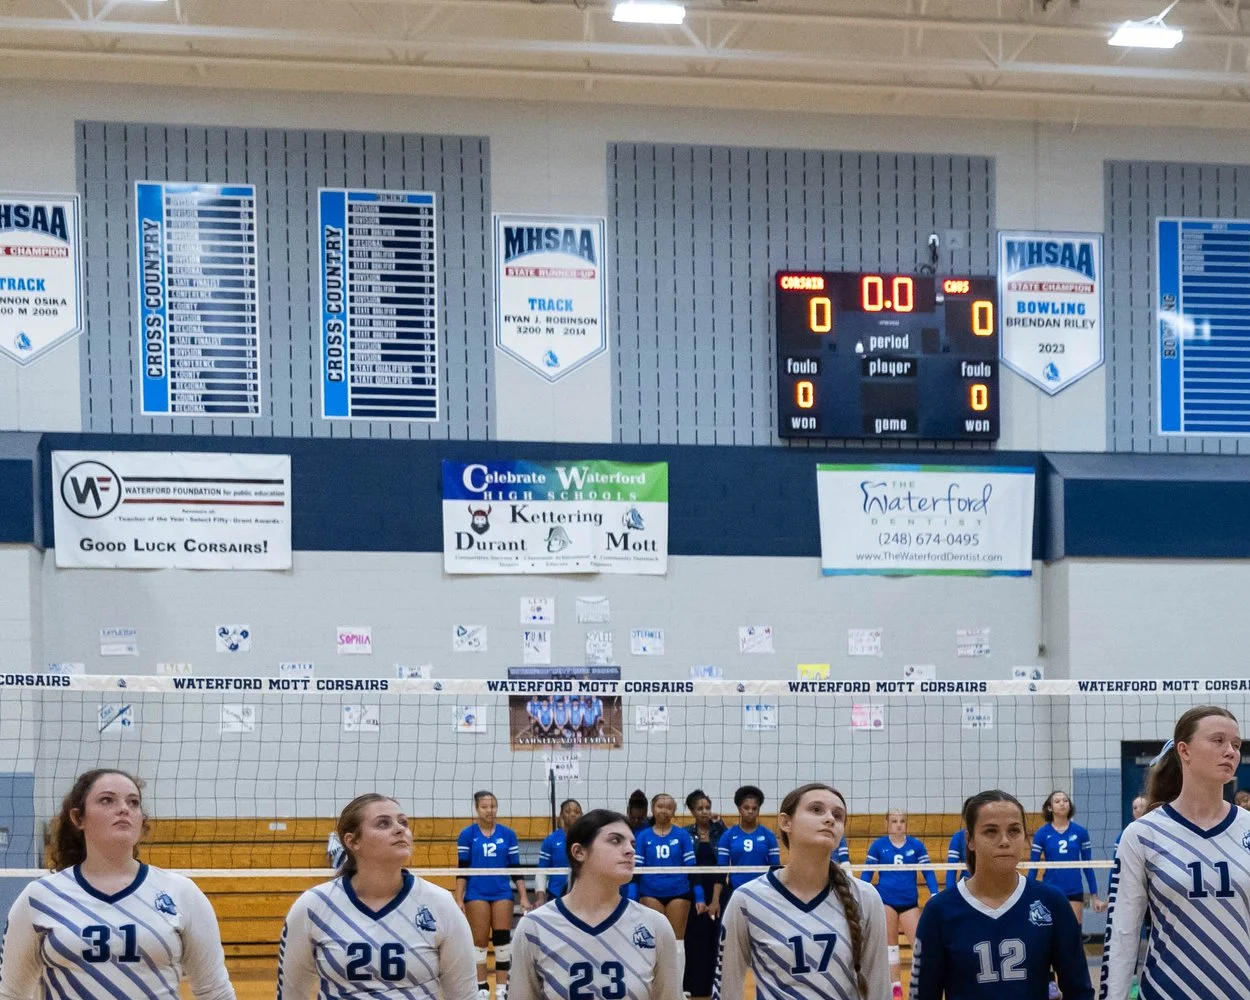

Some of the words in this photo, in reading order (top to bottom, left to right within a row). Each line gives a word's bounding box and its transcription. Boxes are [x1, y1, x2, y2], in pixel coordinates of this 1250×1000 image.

[0, 203, 70, 244] HSAA
[12, 247, 67, 258] CHAMPION
[504, 227, 597, 264] MHSAA
[143, 220, 162, 309] COUNTRY
[1006, 241, 1095, 280] MHSAA
[325, 227, 342, 314] COUNTRY
[508, 268, 536, 277] STATE
[0, 278, 46, 291] TRACK
[1011, 283, 1039, 291] STATE
[1043, 284, 1092, 293] CHAMPION
[0, 297, 30, 305] NNON
[34, 298, 68, 306] OSIKA
[780, 276, 825, 291] CORSAIR
[862, 276, 914, 312] 0.0
[0, 307, 14, 315] 00
[528, 298, 573, 312] TRACK
[1017, 301, 1086, 315] BOWLING
[504, 315, 530, 323] RYAN
[546, 315, 598, 325] ROBINSON
[810, 297, 832, 333] 0
[972, 300, 994, 336] 0
[1006, 318, 1060, 329] BRENDAN
[1064, 318, 1096, 329] RILEY
[516, 327, 541, 335] 3200
[545, 327, 555, 335] M
[563, 328, 586, 336] 2014
[146, 316, 164, 379] CROSS
[870, 334, 910, 352] period
[1038, 343, 1065, 354] 2023
[327, 322, 343, 382] CROSS
[787, 358, 818, 374] fouls
[869, 360, 911, 377] player
[961, 361, 992, 377] fouls
[796, 381, 814, 409] 0
[970, 384, 988, 411] 0
[791, 417, 817, 429] won
[875, 418, 907, 434] game
[965, 420, 990, 432] won
[463, 464, 547, 492] Celebrate
[555, 466, 646, 491] Waterford
[891, 481, 916, 489] THE
[124, 486, 171, 495] WATERFORD
[173, 487, 222, 496] FOUNDATION
[483, 491, 533, 500] HIGH
[547, 491, 637, 500] SCHOOLS
[860, 480, 993, 514] Waterford
[509, 504, 603, 526] Kettering
[871, 518, 982, 526] DENTIST
[455, 531, 528, 551] Durant
[605, 531, 659, 552] Mott
[878, 532, 912, 547] (248)
[916, 533, 980, 547] 674-0495
[855, 552, 1003, 563] www.TheWaterfordDentist.com
[338, 634, 371, 645] SOPHIA
[0, 675, 70, 687] CORSAIRS
[173, 678, 263, 691] WATERFORD
[268, 679, 310, 691] MOTT
[316, 679, 389, 691] CORSAIRS
[487, 681, 573, 693] WATERFORD
[578, 681, 619, 693] MOTT
[624, 681, 694, 693] CORSAIRS
[788, 681, 870, 693] WATERFORD
[876, 681, 915, 693] MOTT
[920, 681, 987, 693] CORSAIRS
[1078, 680, 1157, 692] WATERFORD
[1162, 680, 1199, 691] MOTT
[482, 842, 497, 857] 12
[655, 844, 671, 859] 10
[743, 839, 754, 853] 9
[1058, 839, 1068, 854] 2
[1187, 861, 1235, 899] 11
[81, 923, 141, 964] 31
[788, 933, 837, 975] 17
[973, 938, 1027, 984] 12
[346, 942, 407, 982] 26
